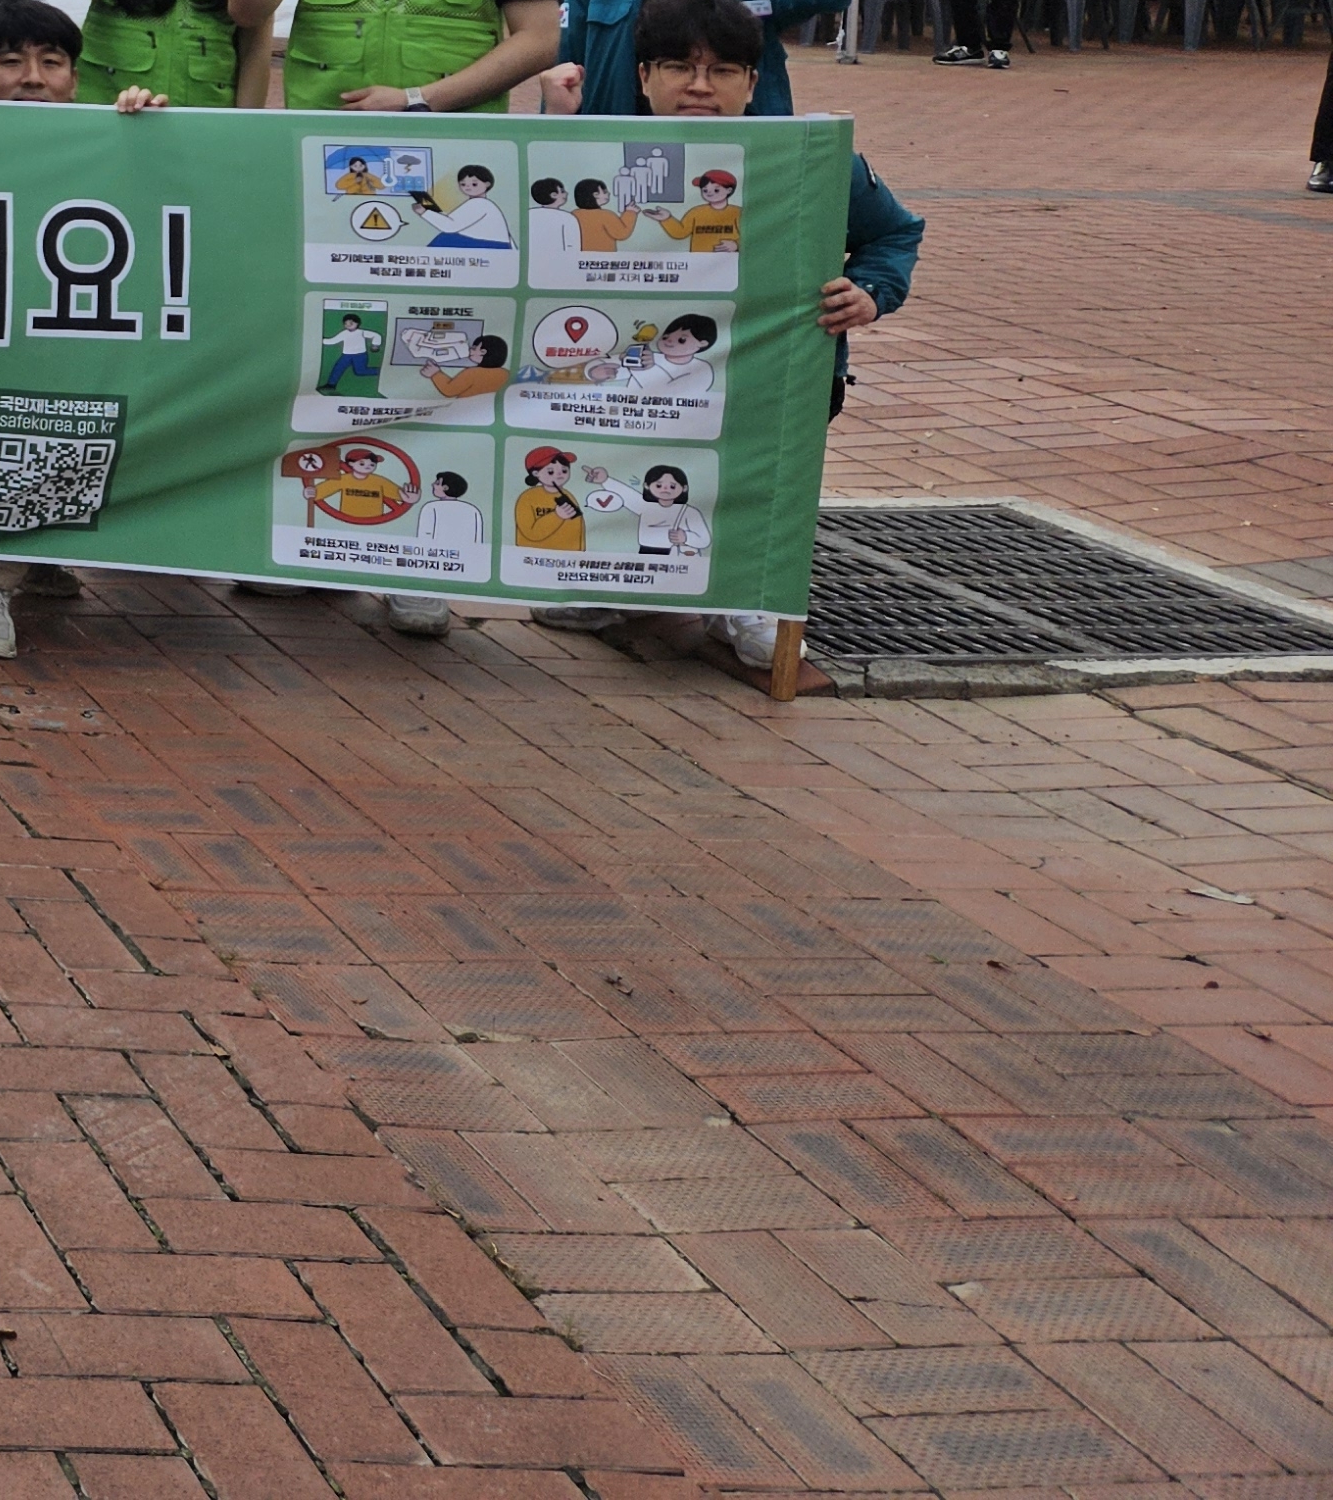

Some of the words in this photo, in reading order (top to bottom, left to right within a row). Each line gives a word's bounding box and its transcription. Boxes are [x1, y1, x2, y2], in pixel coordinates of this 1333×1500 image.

[331, 252, 384, 264] 일기예보를
[388, 254, 430, 266] 확인하고
[434, 255, 465, 267] 날씨에
[578, 260, 630, 270] 안전요원의
[633, 261, 664, 271] 안내에
[667, 261, 688, 271] 따라
[370, 267, 402, 278] 복장과
[405, 267, 426, 278] 물품
[430, 268, 451, 279] 준비
[586, 272, 616, 283] 질서를
[619, 273, 641, 283] 지켜
[408, 306, 441, 316] 축제장
[443, 307, 474, 317] 배치도
[545, 346, 601, 357] 종합안내소
[0, 395, 119, 418] 국민재난안전포털
[520, 390, 577, 401] 축제장에서
[580, 392, 603, 402] 서로
[606, 393, 639, 405] 헤어질
[641, 395, 673, 406] 상황에
[676, 397, 710, 408] 대비해
[337, 405, 372, 415] 축제장
[550, 402, 606, 414] 종합안내소
[622, 406, 644, 417] 만날
[647, 408, 680, 420] 장소와
[574, 416, 596, 427] 연락
[599, 417, 620, 428] 방법
[623, 419, 657, 431] 정하기
[366, 541, 400, 554] 안전선
[427, 547, 460, 559] 설치된
[299, 548, 321, 559] 출입
[324, 550, 346, 562] 금지
[349, 553, 393, 566] 구역에는
[396, 557, 440, 571] 들어가지
[443, 561, 465, 573] 않기
[523, 556, 576, 568] 축제장에서
[579, 559, 612, 571] 위험한
[614, 561, 645, 572] 상황을
[648, 563, 689, 574] 목격하면
[557, 572, 620, 583] 안전요원에게
[623, 573, 654, 585] 알리기
